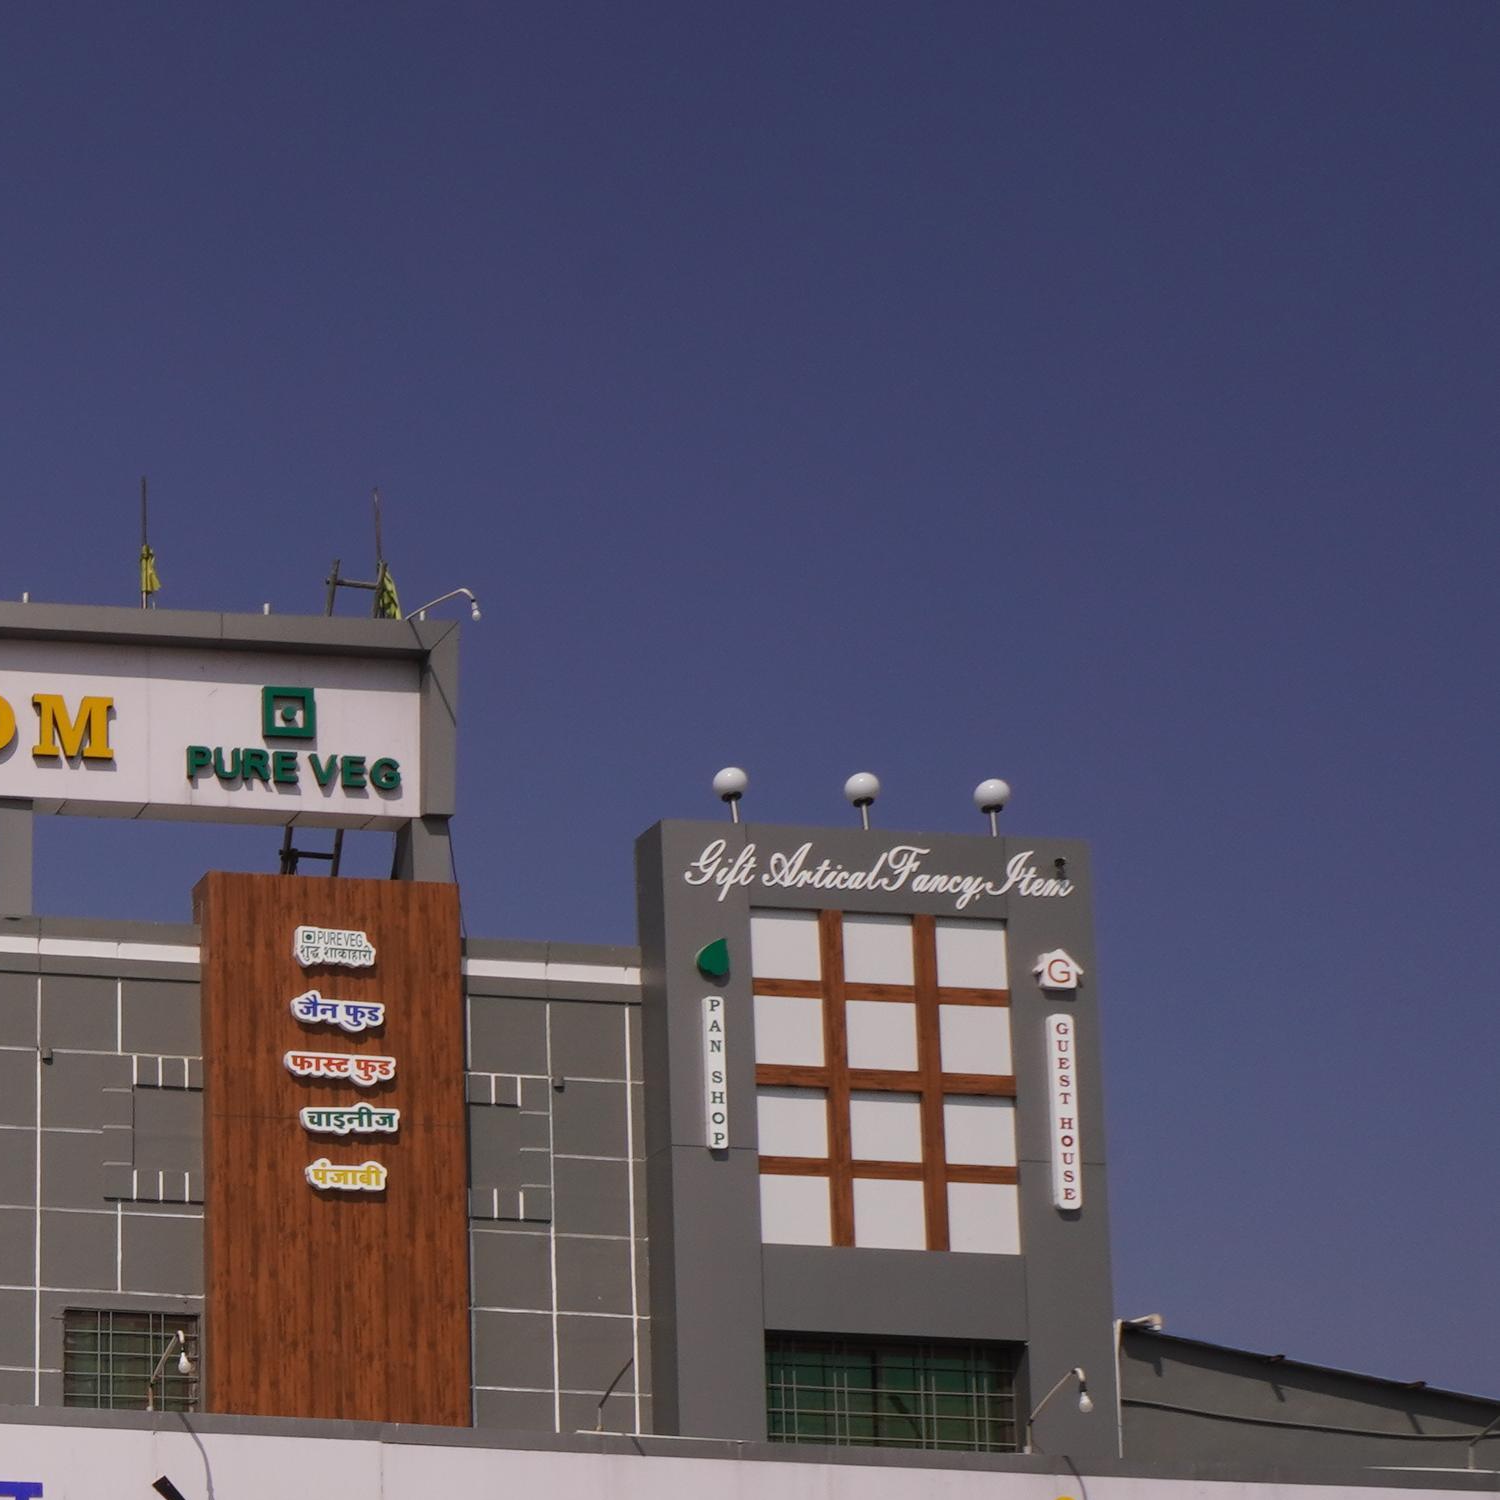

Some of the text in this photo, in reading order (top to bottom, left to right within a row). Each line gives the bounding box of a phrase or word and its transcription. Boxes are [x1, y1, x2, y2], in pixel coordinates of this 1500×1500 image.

[187, 744, 402, 792] PURE VEG
[684, 839, 756, 901] Gift
[762, 843, 888, 889] Artical
[984, 850, 1075, 897] Item
[317, 931, 362, 947] PURE VEG
[300, 945, 320, 961] शुद्ध
[1047, 959, 1071, 984] G
[299, 994, 381, 1027] जैन फुड
[291, 1054, 393, 1079] फास्ट फुड
[708, 999, 726, 1146] PAN SHOP
[307, 1106, 396, 1130] चाइनीज
[1055, 1021, 1077, 1201] GUEST HOUSE
[312, 1162, 383, 1187] पंजाबी
